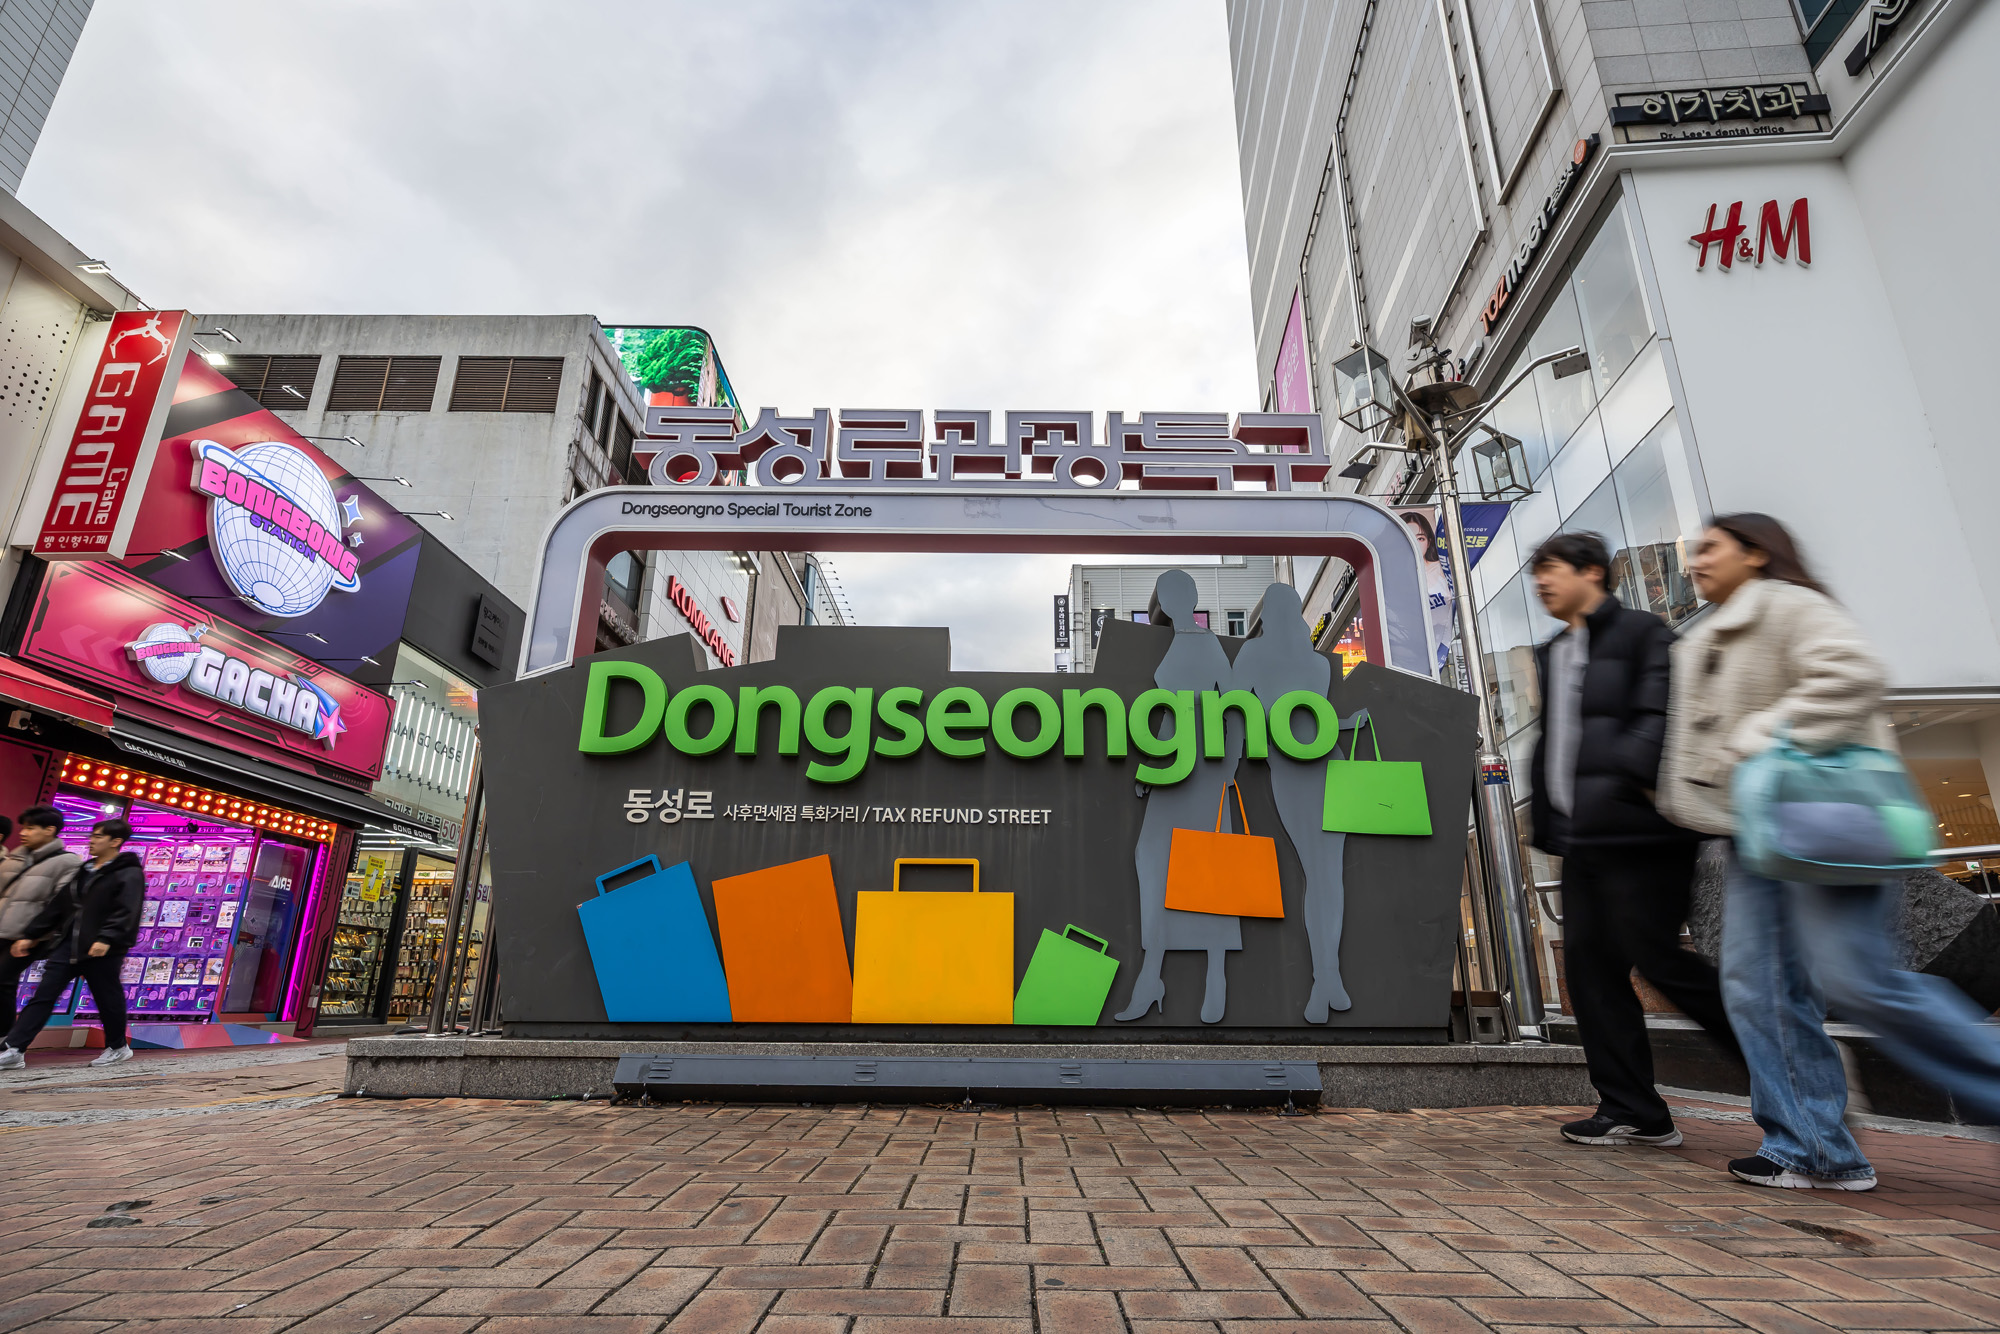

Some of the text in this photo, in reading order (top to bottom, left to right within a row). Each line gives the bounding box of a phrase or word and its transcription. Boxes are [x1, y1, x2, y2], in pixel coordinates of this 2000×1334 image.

[1643, 84, 1805, 123] 이가치과
[1660, 126, 1785, 140] Dr. Lee's dental office
[1688, 197, 1812, 271] H&M
[51, 362, 142, 526] GAME
[632, 406, 1333, 491] 동성로관광특구
[94, 467, 128, 525] Crane
[200, 456, 360, 582] BONGBONG
[621, 501, 872, 519] Dongseongno Special Tourist Zone
[58, 535, 109, 549] 인형카페
[250, 513, 316, 563] STATION
[668, 575, 735, 668] KUMKANG
[189, 644, 320, 734] GACHA
[434, 740, 462, 763] CASE
[578, 660, 1339, 785] Dongseongno
[623, 788, 715, 824] 동성로
[723, 804, 798, 823] 사후면세점
[800, 805, 859, 823] 특화거리
[873, 807, 906, 823] TAX
[911, 808, 983, 824] REFUND
[987, 808, 1052, 825] STREET
